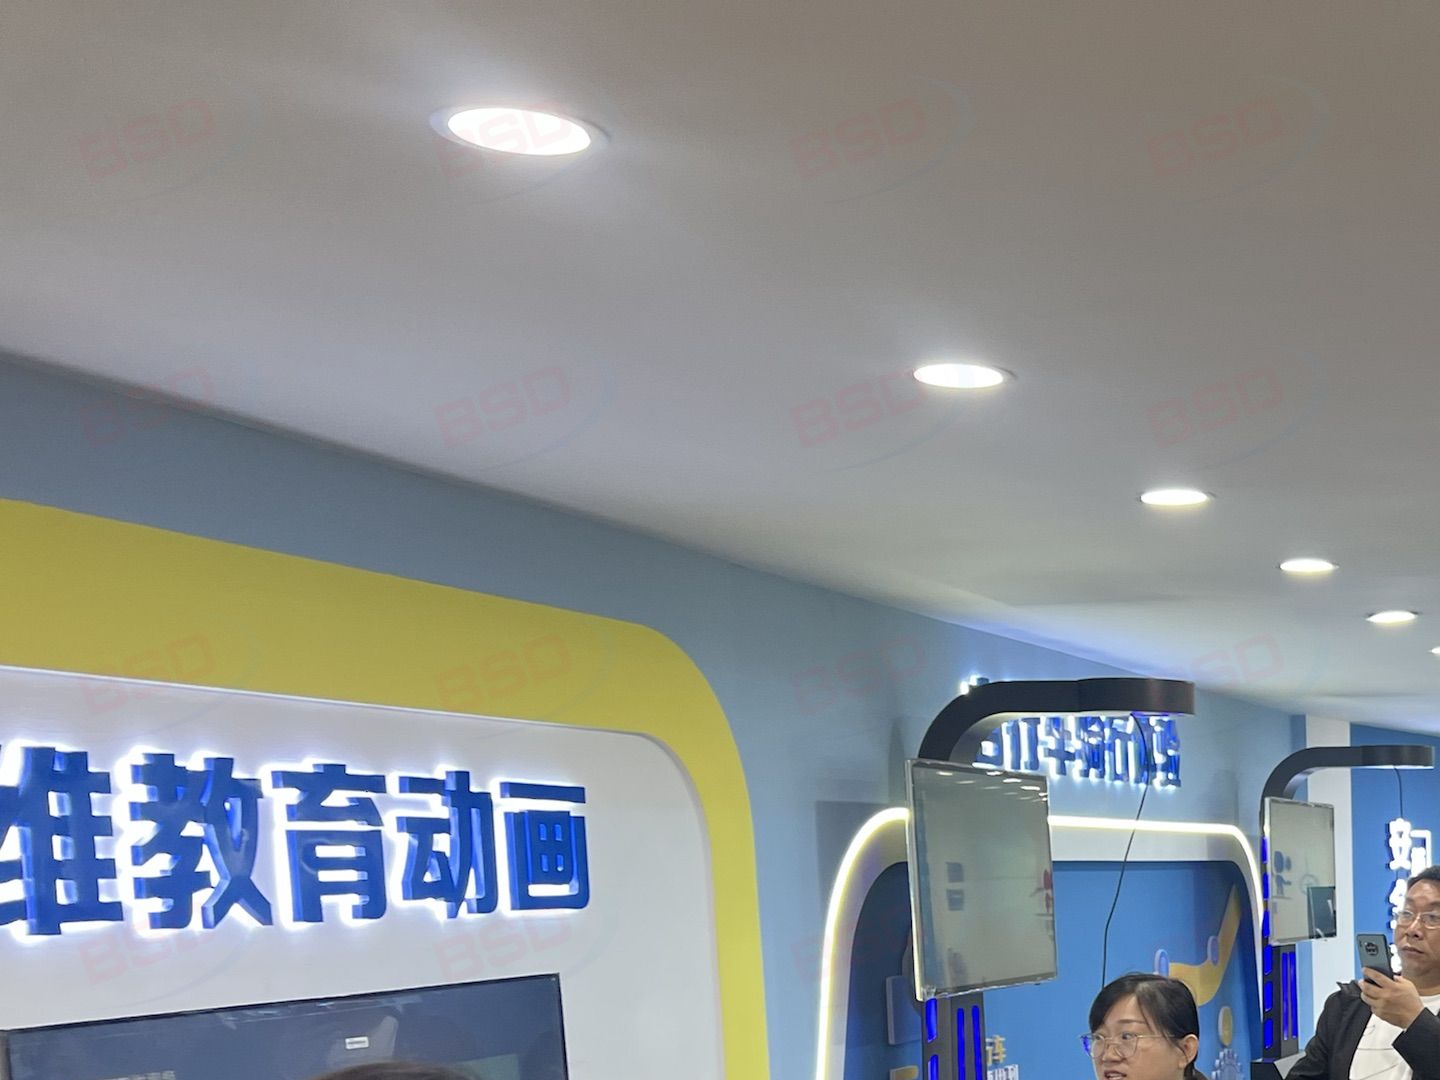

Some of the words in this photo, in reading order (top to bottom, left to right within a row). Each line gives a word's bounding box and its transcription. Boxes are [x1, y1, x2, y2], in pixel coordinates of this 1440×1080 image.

[0, 746, 591, 936] 维教育动画
